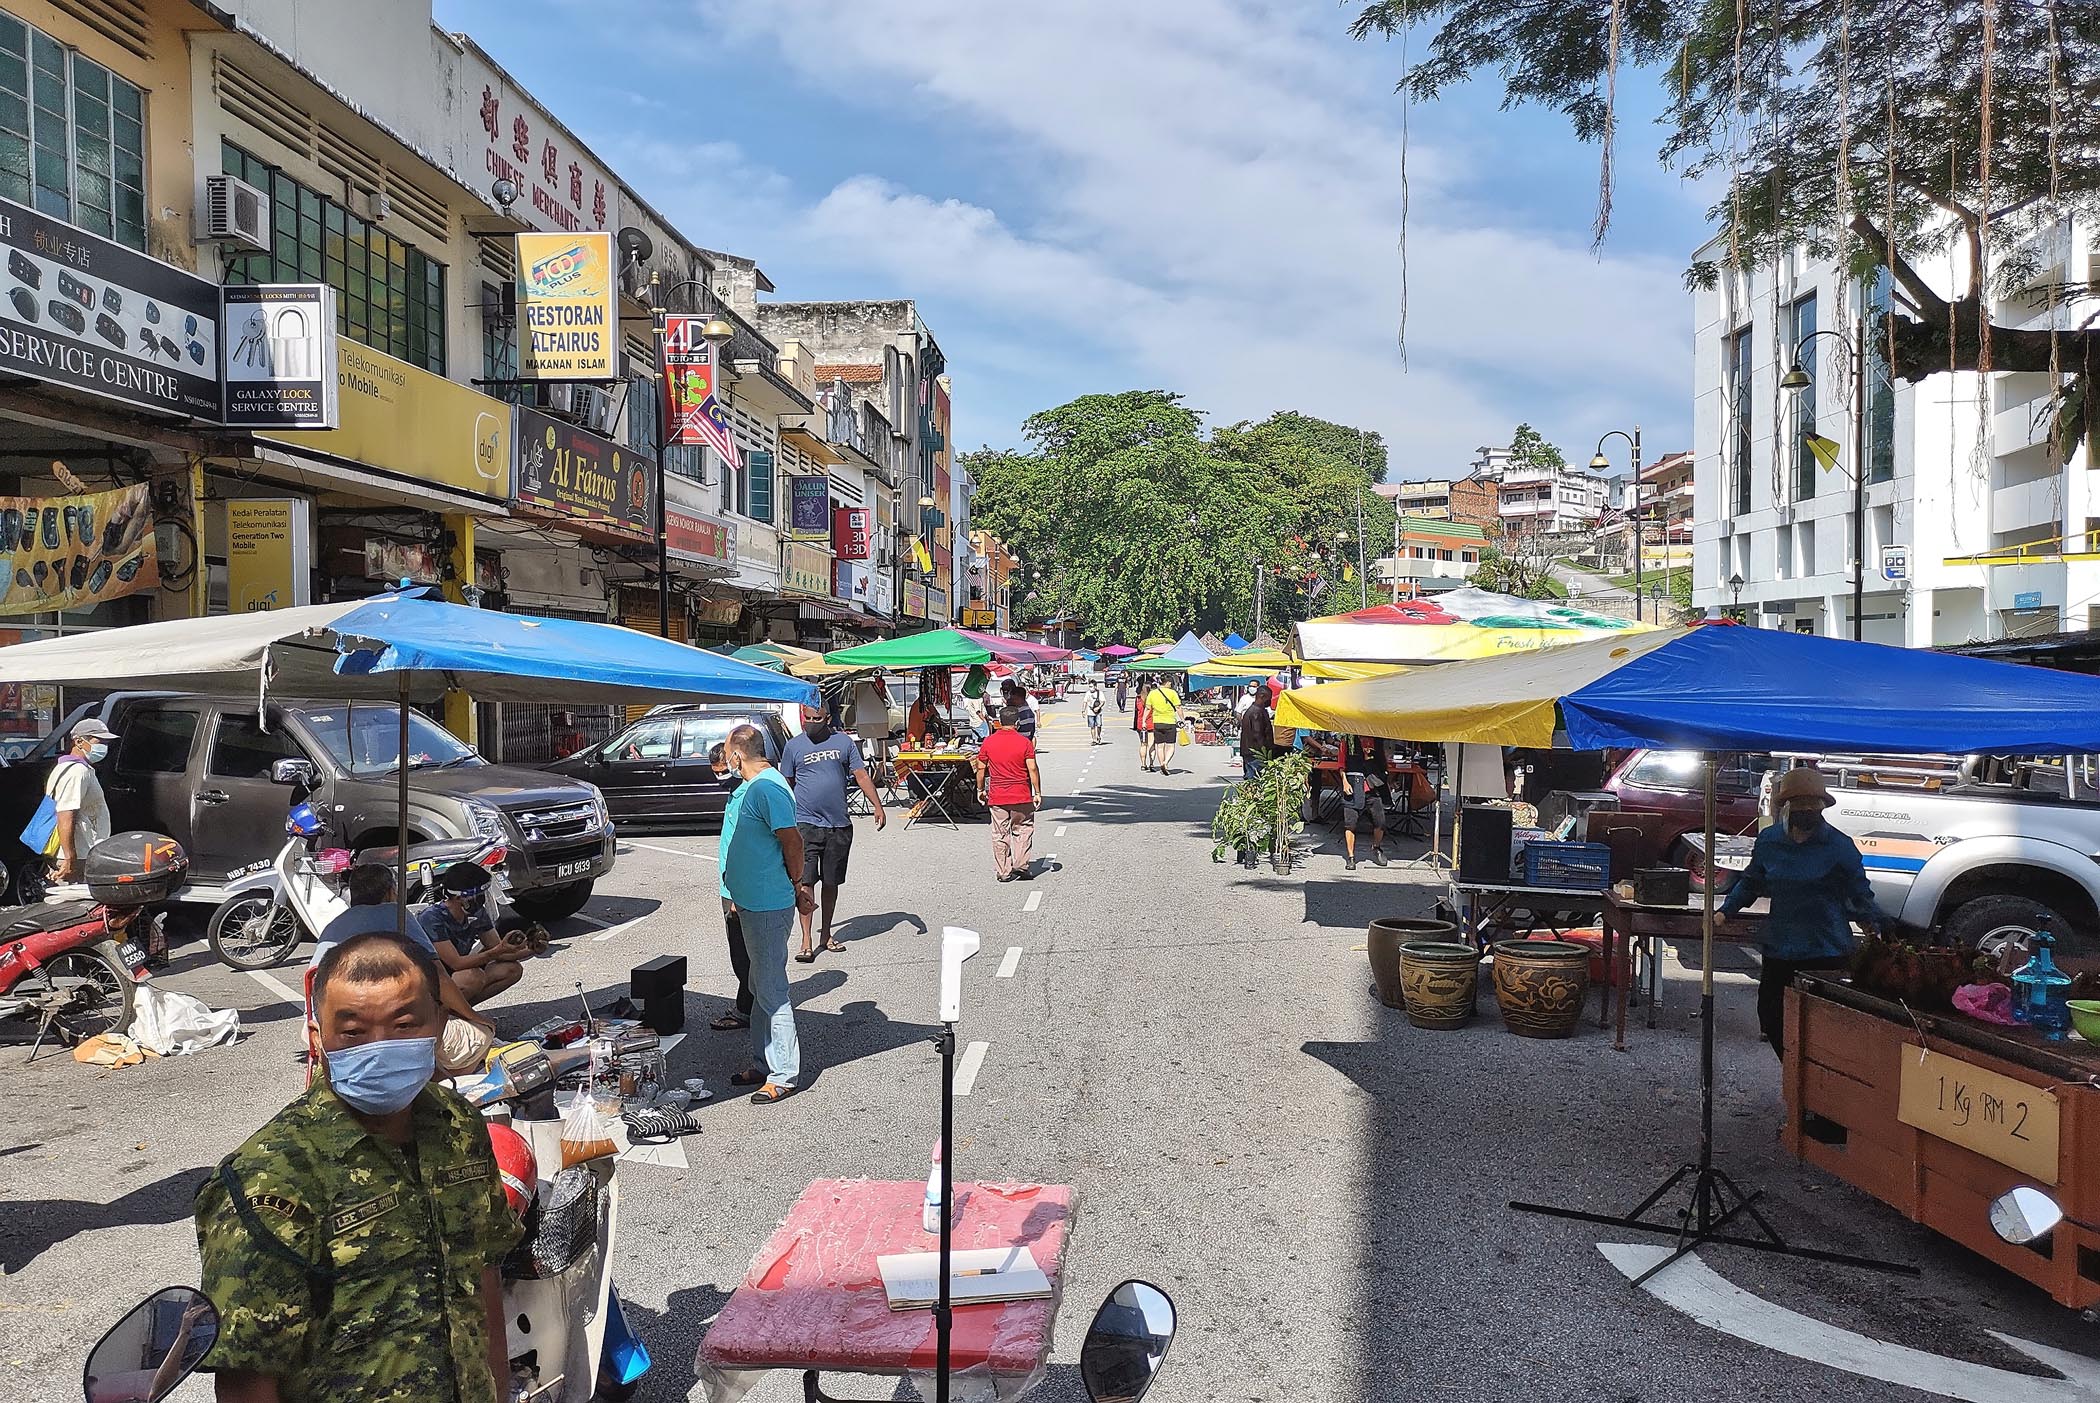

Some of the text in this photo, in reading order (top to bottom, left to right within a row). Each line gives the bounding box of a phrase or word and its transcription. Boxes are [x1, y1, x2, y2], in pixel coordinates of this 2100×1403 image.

[486, 147, 525, 198] CHINESE
[548, 271, 582, 290] PLUS
[527, 304, 604, 326] RESTORAN
[531, 331, 600, 352] ALFAIRUS
[667, 319, 708, 351] 4D
[0, 326, 179, 401] SERVICE CENTRE
[342, 349, 406, 387] Telekomunikasi
[525, 358, 606, 370] MAKANAN ISLAM
[236, 389, 312, 399] GALAXY LOCK
[347, 373, 379, 398] Mobile
[231, 402, 319, 412] SERVICE CENTRE
[549, 447, 570, 488] Al
[573, 455, 617, 502] Fairus
[232, 508, 287, 517] Kedai Peralatan
[232, 521, 287, 529] Telekomunikasi
[270, 532, 285, 540] Two
[852, 532, 866, 542] 3D
[1496, 635, 1535, 649] Fresh
[804, 750, 841, 765] ESPRIT
[1840, 808, 1911, 820] COMMONRAIL
[226, 859, 271, 880] NBF 7430
[574, 859, 591, 874] 9139
[1938, 1076, 2030, 1141] 1 Kg RM 2
[251, 1196, 291, 1216] RELA
[336, 1212, 358, 1228] LEE
